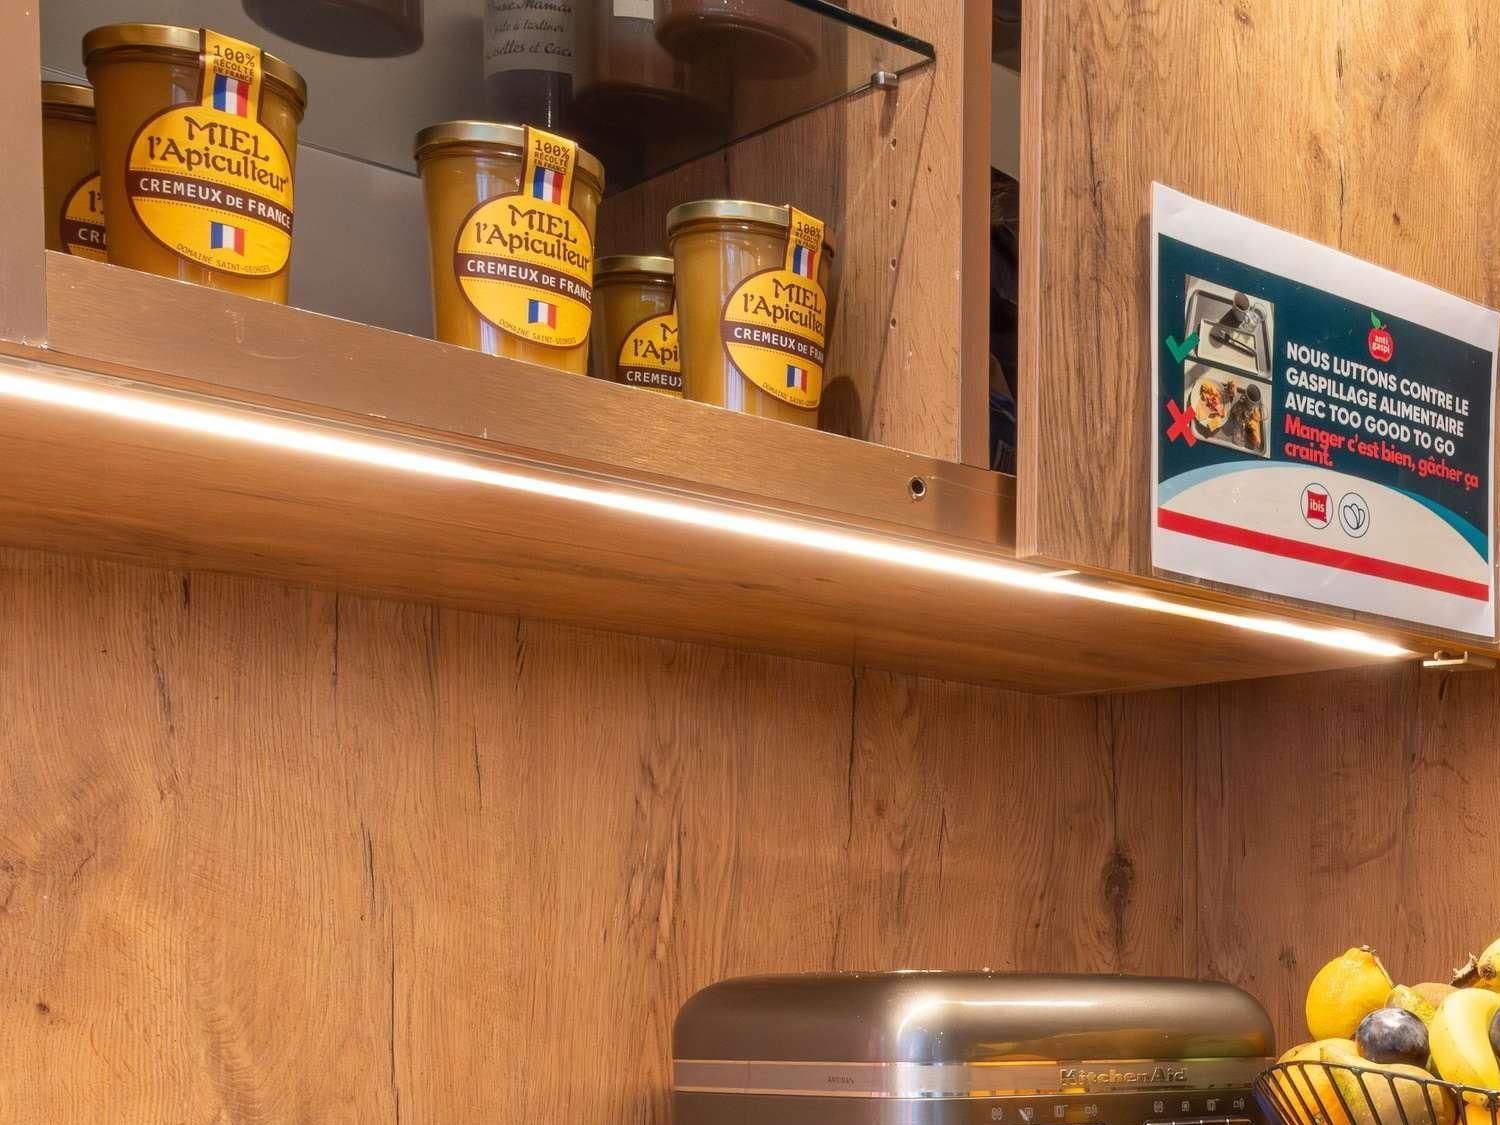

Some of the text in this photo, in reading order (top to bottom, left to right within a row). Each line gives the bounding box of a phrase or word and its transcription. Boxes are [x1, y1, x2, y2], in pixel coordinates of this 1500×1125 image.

[213, 45, 256, 68] 100%
[184, 116, 270, 162] MIEL
[534, 140, 570, 161] 100%
[139, 177, 292, 230] CREMEUX DE FRANCE
[508, 203, 578, 245] MIEL
[467, 259, 539, 283] CREMEUX
[541, 273, 556, 288] DE
[771, 277, 823, 315] MIEL
[734, 326, 796, 350] CREMEUX
[797, 341, 808, 355] DE
[1371, 342, 1391, 355] gaspi
[1374, 334, 1390, 347] anti
[1286, 341, 1470, 417] NOUS LUTTONS CONTRE LE
[1286, 366, 1465, 438] GASPILLAGE ALIMENTAIRE
[1285, 391, 1456, 457] AVEC TOO GOOD TO GO
[1284, 414, 1479, 491] Manger c'est bien, gâcher ça
[1284, 442, 1333, 467] craint.
[1309, 498, 1326, 513] ibis
